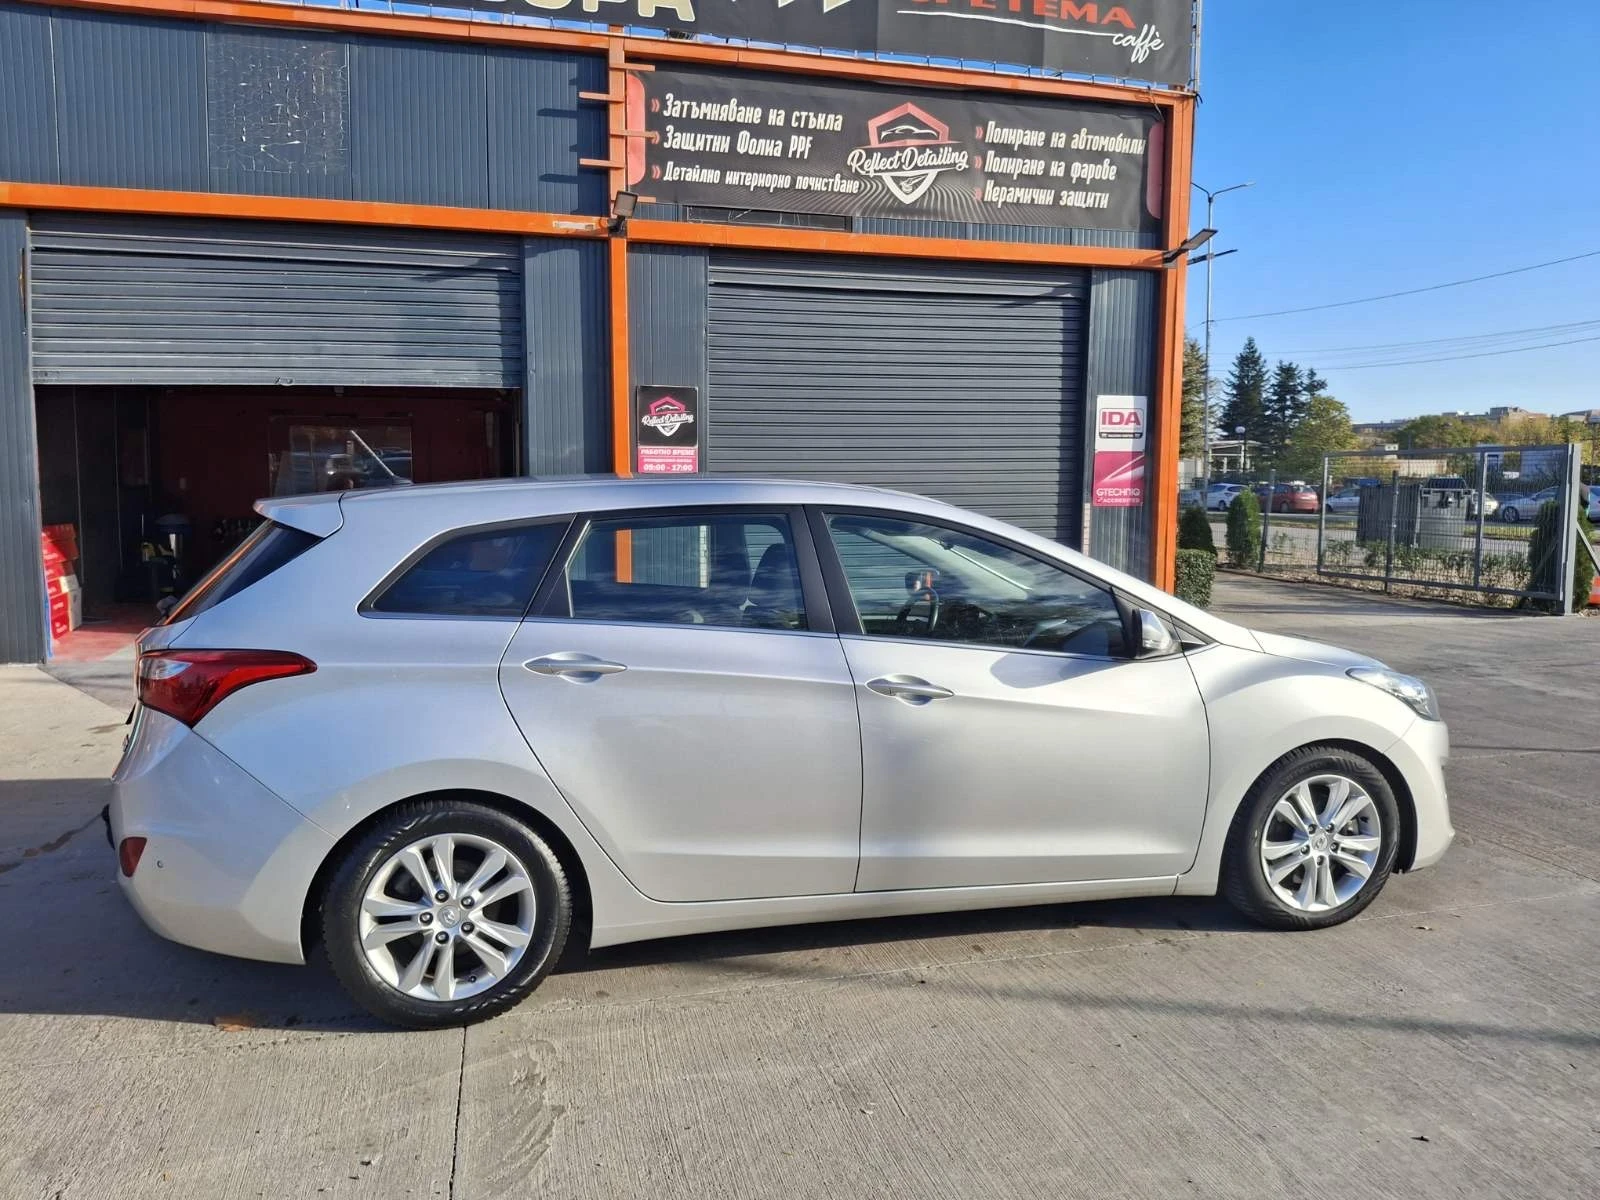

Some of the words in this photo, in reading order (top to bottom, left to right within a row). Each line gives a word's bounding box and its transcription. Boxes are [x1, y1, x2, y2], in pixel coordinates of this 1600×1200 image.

[1112, 24, 1164, 63] caffè
[663, 92, 762, 125] Затъмняване
[768, 109, 786, 127] на
[791, 110, 843, 132] стъкла
[663, 125, 731, 154] Защитни
[788, 135, 813, 159] PPF
[984, 121, 1046, 151] Полиране
[1050, 131, 1067, 149] на
[1071, 128, 1147, 155] автомобили
[663, 161, 721, 185] Детайлно
[725, 170, 792, 193] интериорно
[795, 173, 860, 195] почистване
[847, 149, 903, 178] Reflect
[901, 147, 969, 171] Detailing
[984, 150, 1046, 180] Полиране
[1049, 161, 1066, 177] на
[1070, 158, 1118, 184] фарове
[984, 180, 1055, 208] Керамични
[1059, 190, 1110, 209] защити
[1101, 411, 1141, 426] IDA
[1096, 488, 1141, 497] GTECHNIQ
